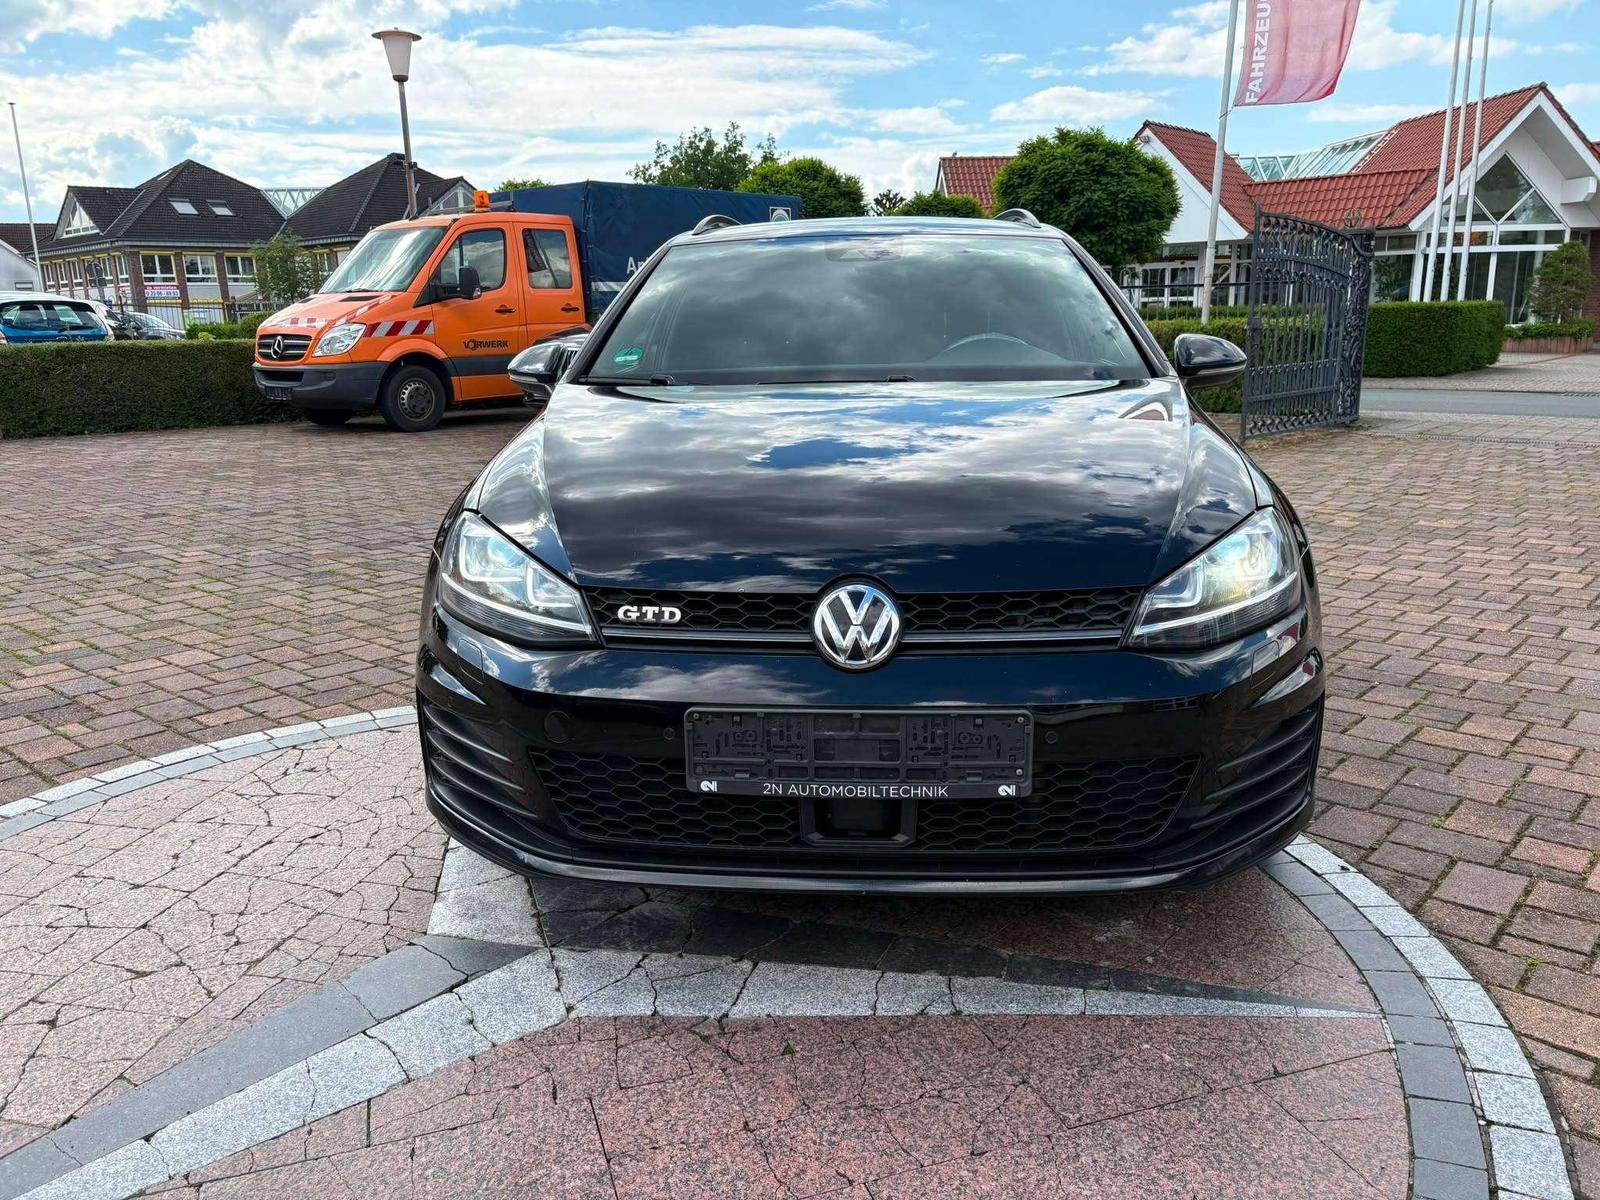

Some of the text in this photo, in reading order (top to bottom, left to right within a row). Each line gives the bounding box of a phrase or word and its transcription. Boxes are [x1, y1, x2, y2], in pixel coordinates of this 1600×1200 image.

[1245, 0, 1272, 104] FAHRZEU
[463, 339, 509, 351] VORWERK
[617, 605, 682, 624] GTD
[762, 783, 949, 798] 2N AUTOMOBILTECHNIK
